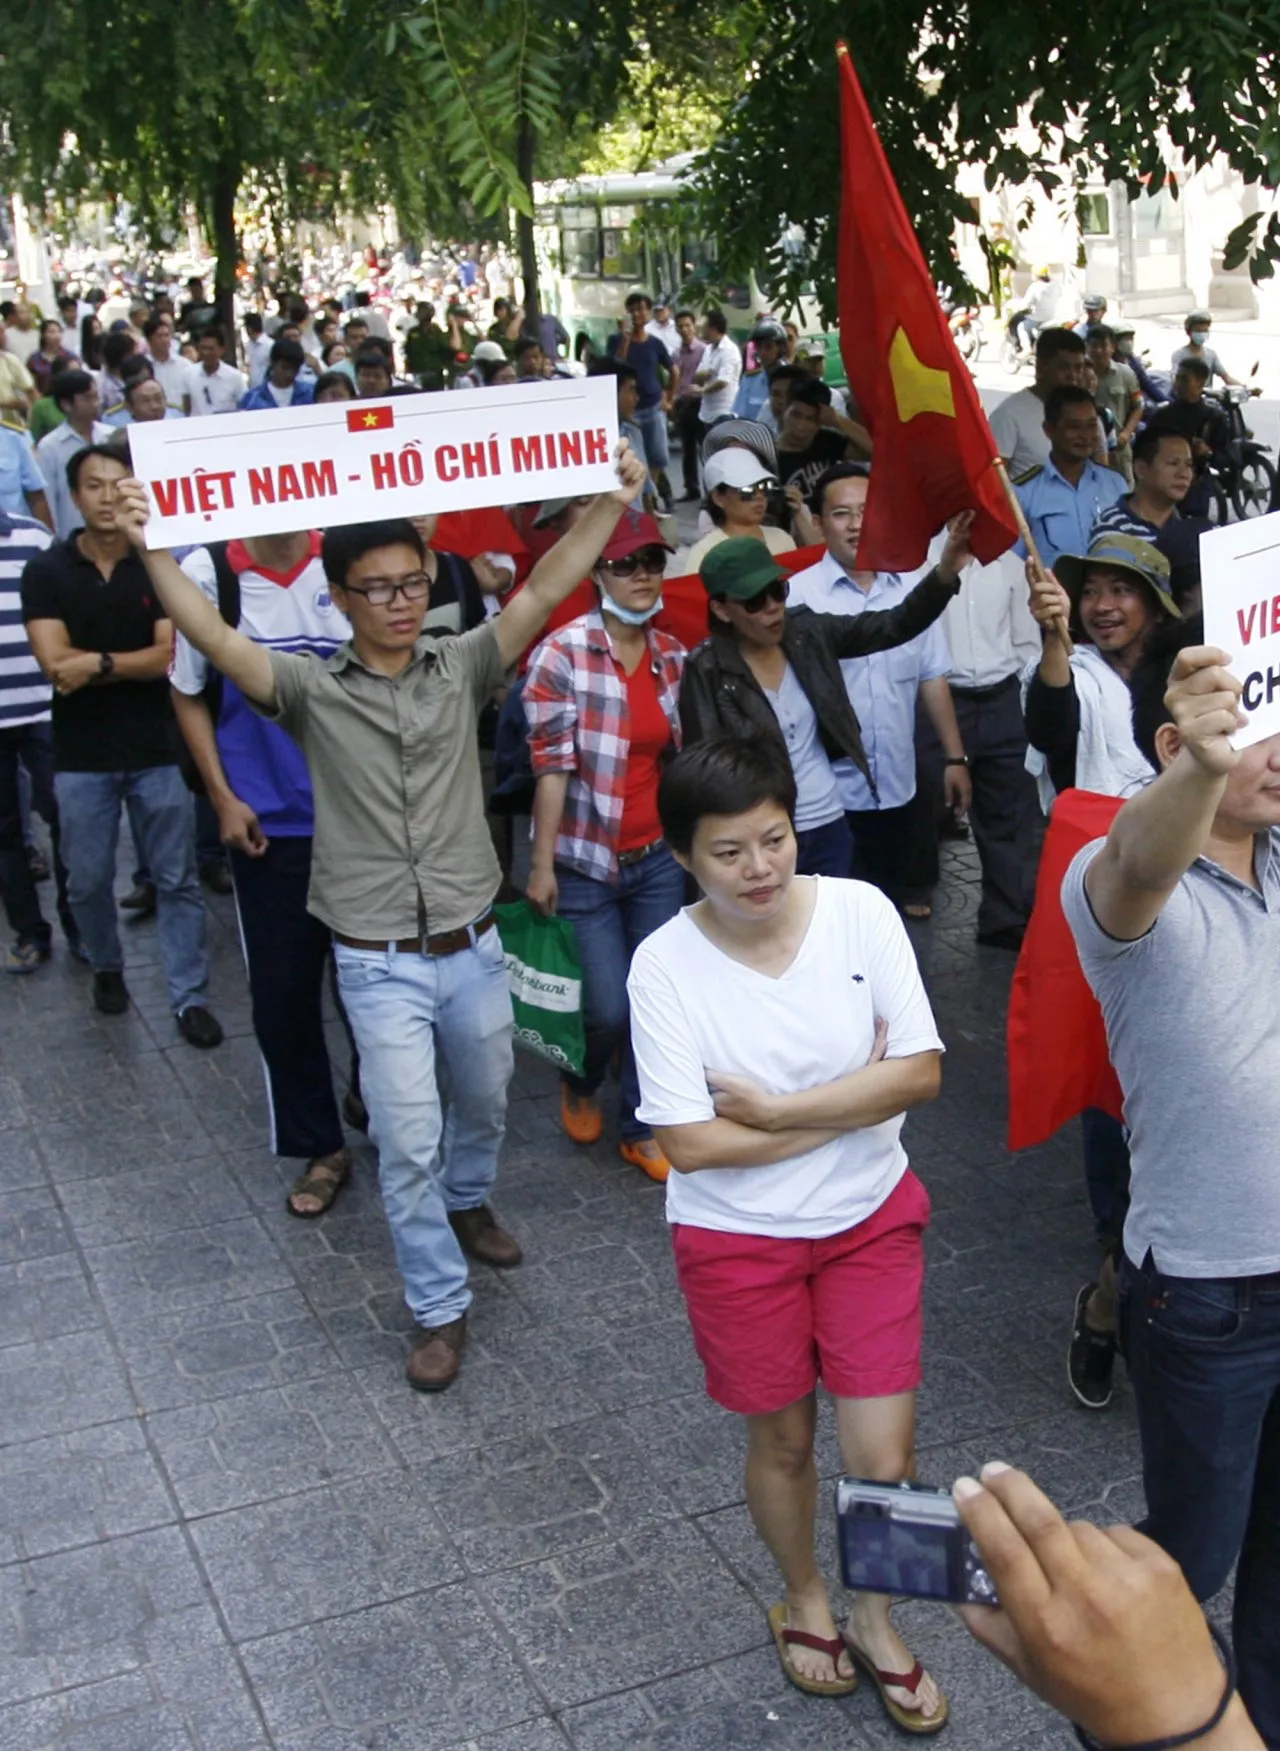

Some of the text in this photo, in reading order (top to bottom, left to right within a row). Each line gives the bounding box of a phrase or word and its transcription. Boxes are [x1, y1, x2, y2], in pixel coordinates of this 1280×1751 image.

[151, 427, 609, 522] VIỆT NAM - HỒ CHÍ MINH
